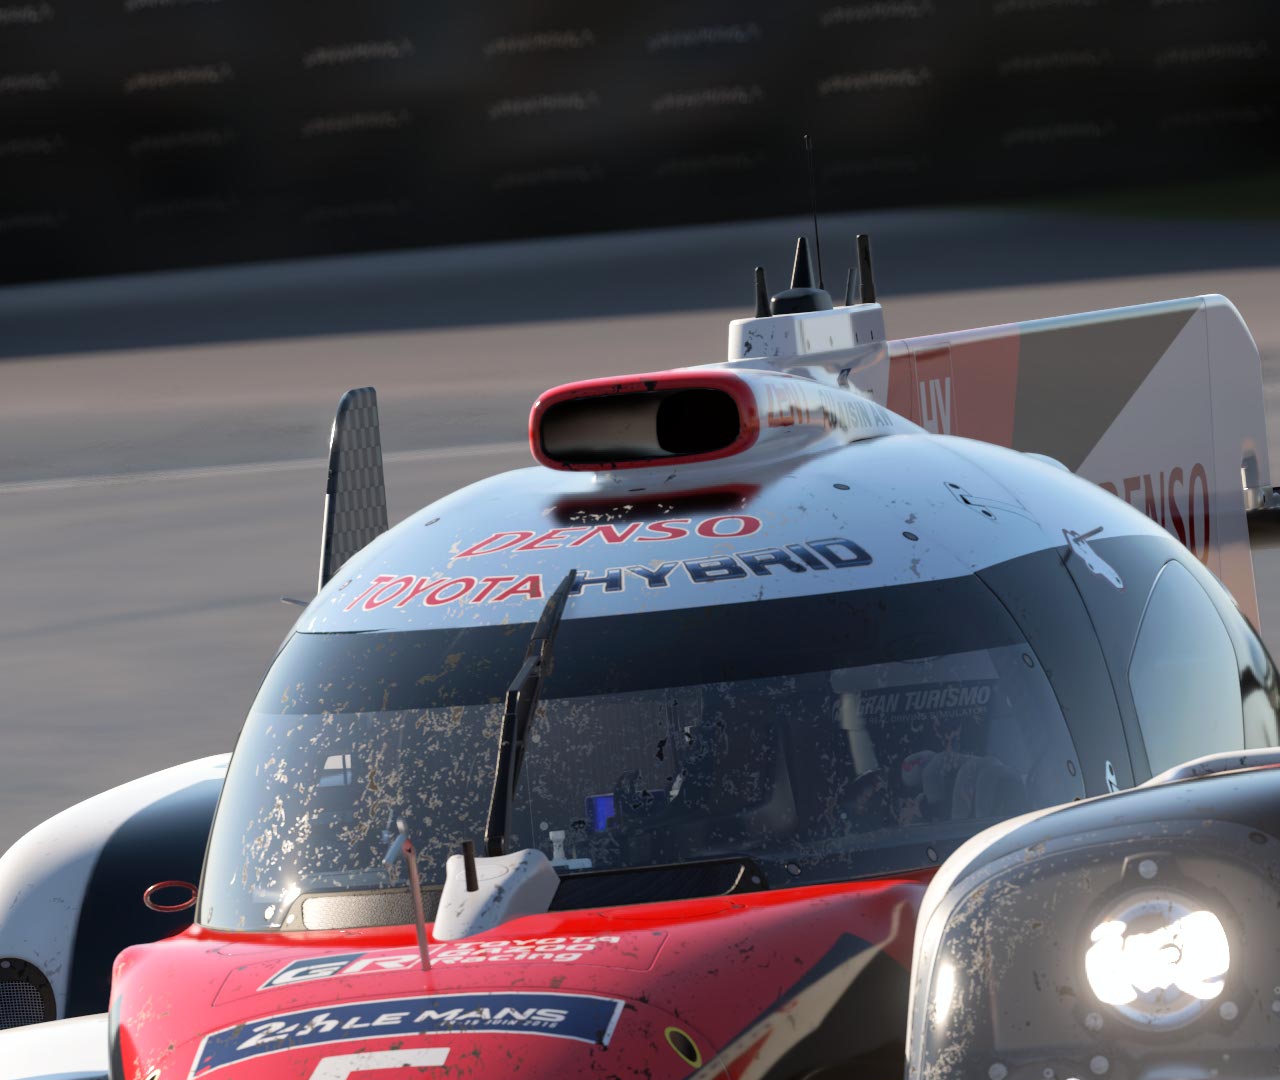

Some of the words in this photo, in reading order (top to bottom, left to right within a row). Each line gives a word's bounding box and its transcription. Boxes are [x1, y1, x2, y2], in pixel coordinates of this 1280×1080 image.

[1100, 462, 1210, 567] NSO
[453, 515, 762, 559] DENSO
[345, 574, 545, 612] TOYOTA
[567, 537, 874, 596] HYBRID
[905, 685, 992, 712] TURISMO
[437, 943, 598, 958] GAZOO
[455, 935, 621, 949] TOYOTA
[428, 951, 583, 966] Racing
[341, 1012, 411, 1032] LE
[413, 1007, 570, 1023] MANS
